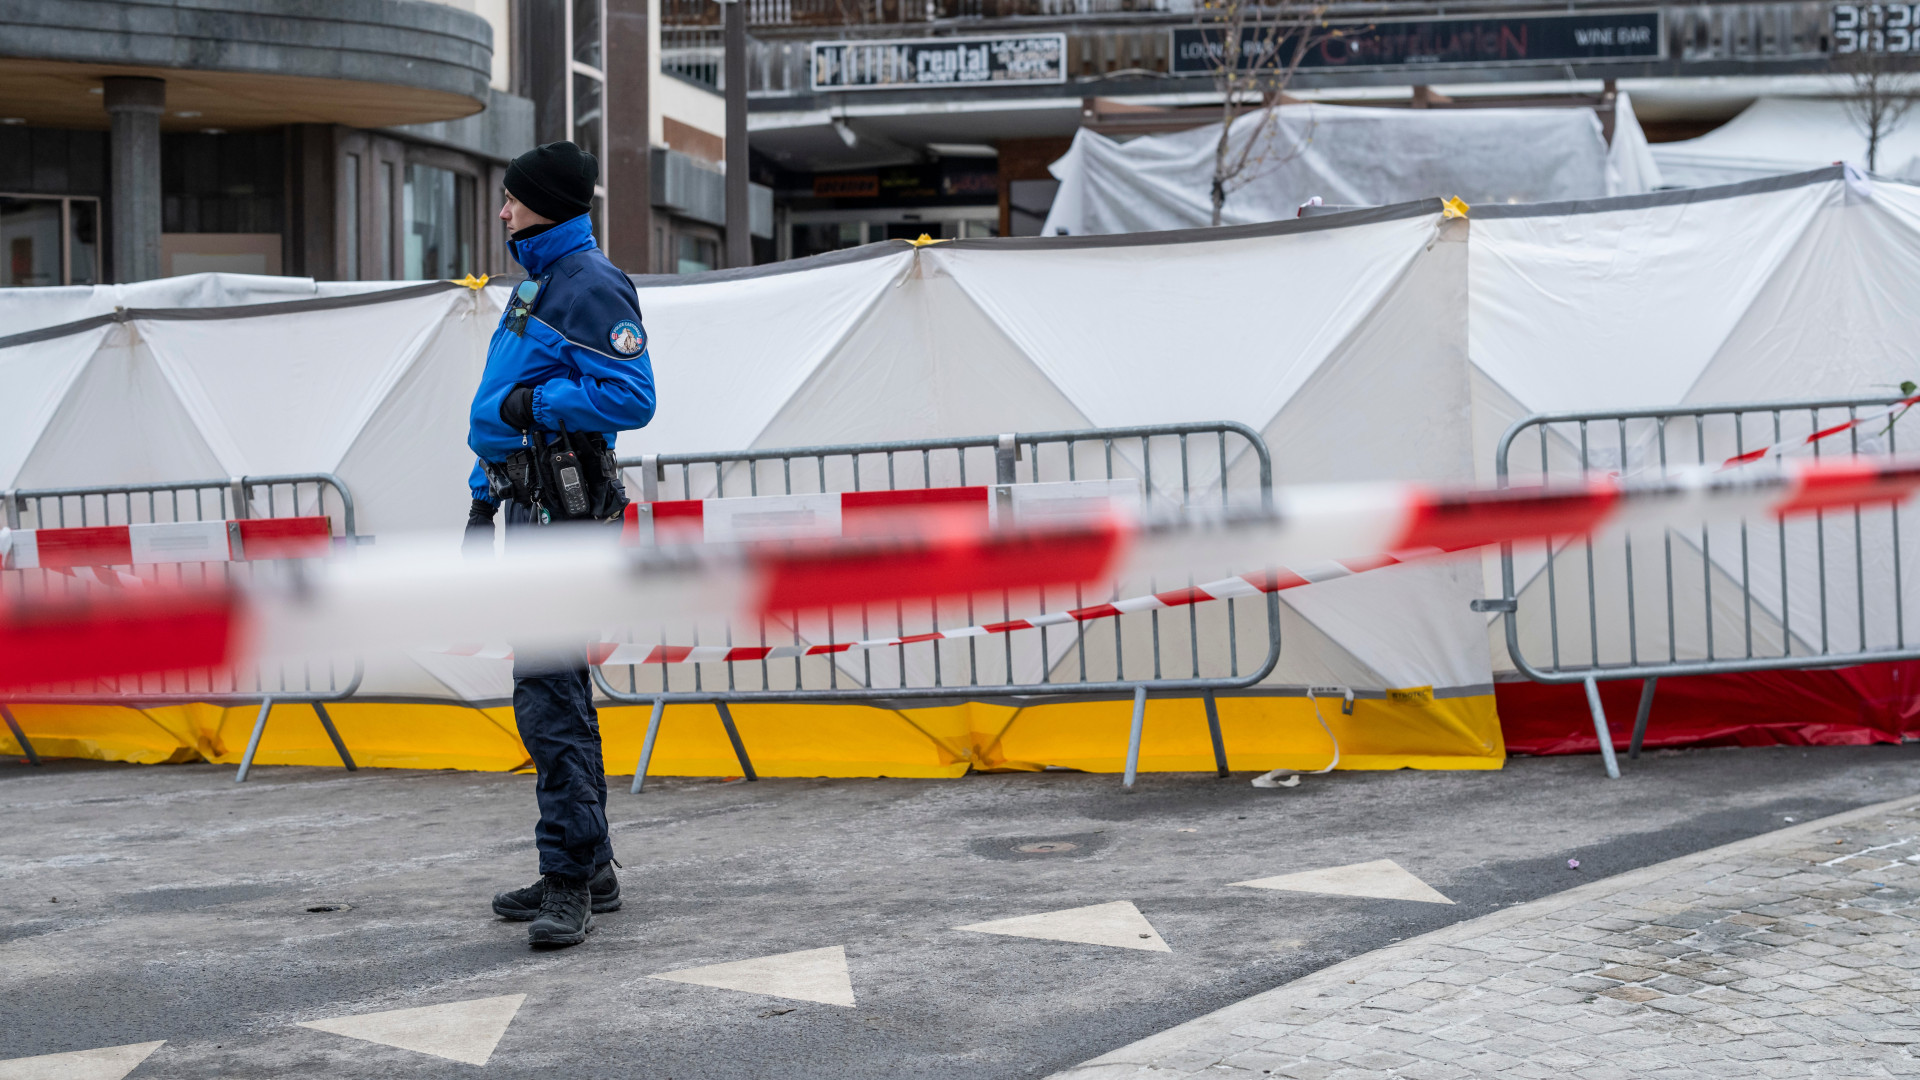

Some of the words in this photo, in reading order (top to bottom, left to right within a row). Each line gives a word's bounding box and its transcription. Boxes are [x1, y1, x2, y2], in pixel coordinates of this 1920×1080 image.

[1574, 28, 1614, 46] WINE
[1616, 26, 1651, 44] BAR
[916, 44, 990, 72] rental
